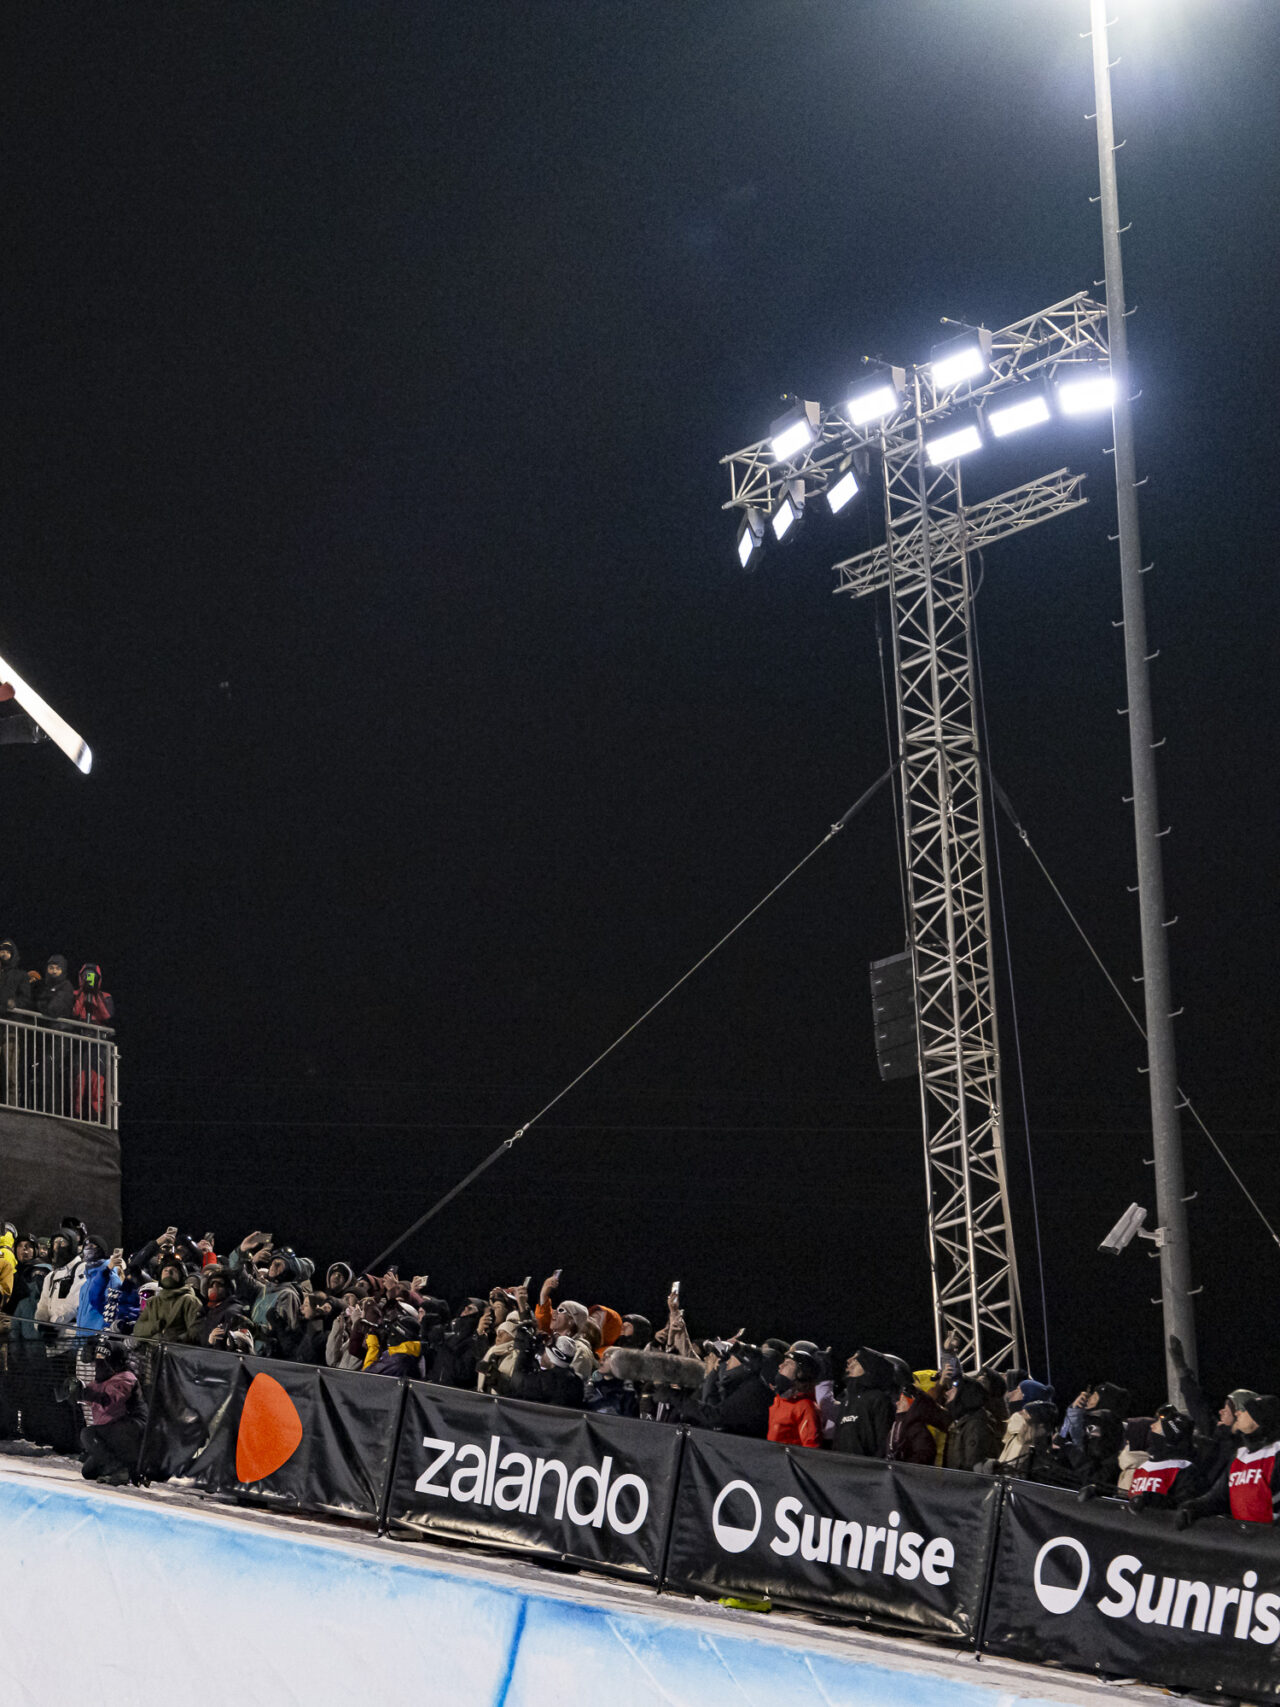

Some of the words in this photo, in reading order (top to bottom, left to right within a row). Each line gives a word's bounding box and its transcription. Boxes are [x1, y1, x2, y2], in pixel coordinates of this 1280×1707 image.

[415, 1436, 649, 1535] zalando
[1131, 1476, 1163, 1493] STAFF
[1228, 1468, 1263, 1488] STAFF
[769, 1496, 956, 1586] Sunrise
[1096, 1554, 1280, 1645] Sunris
